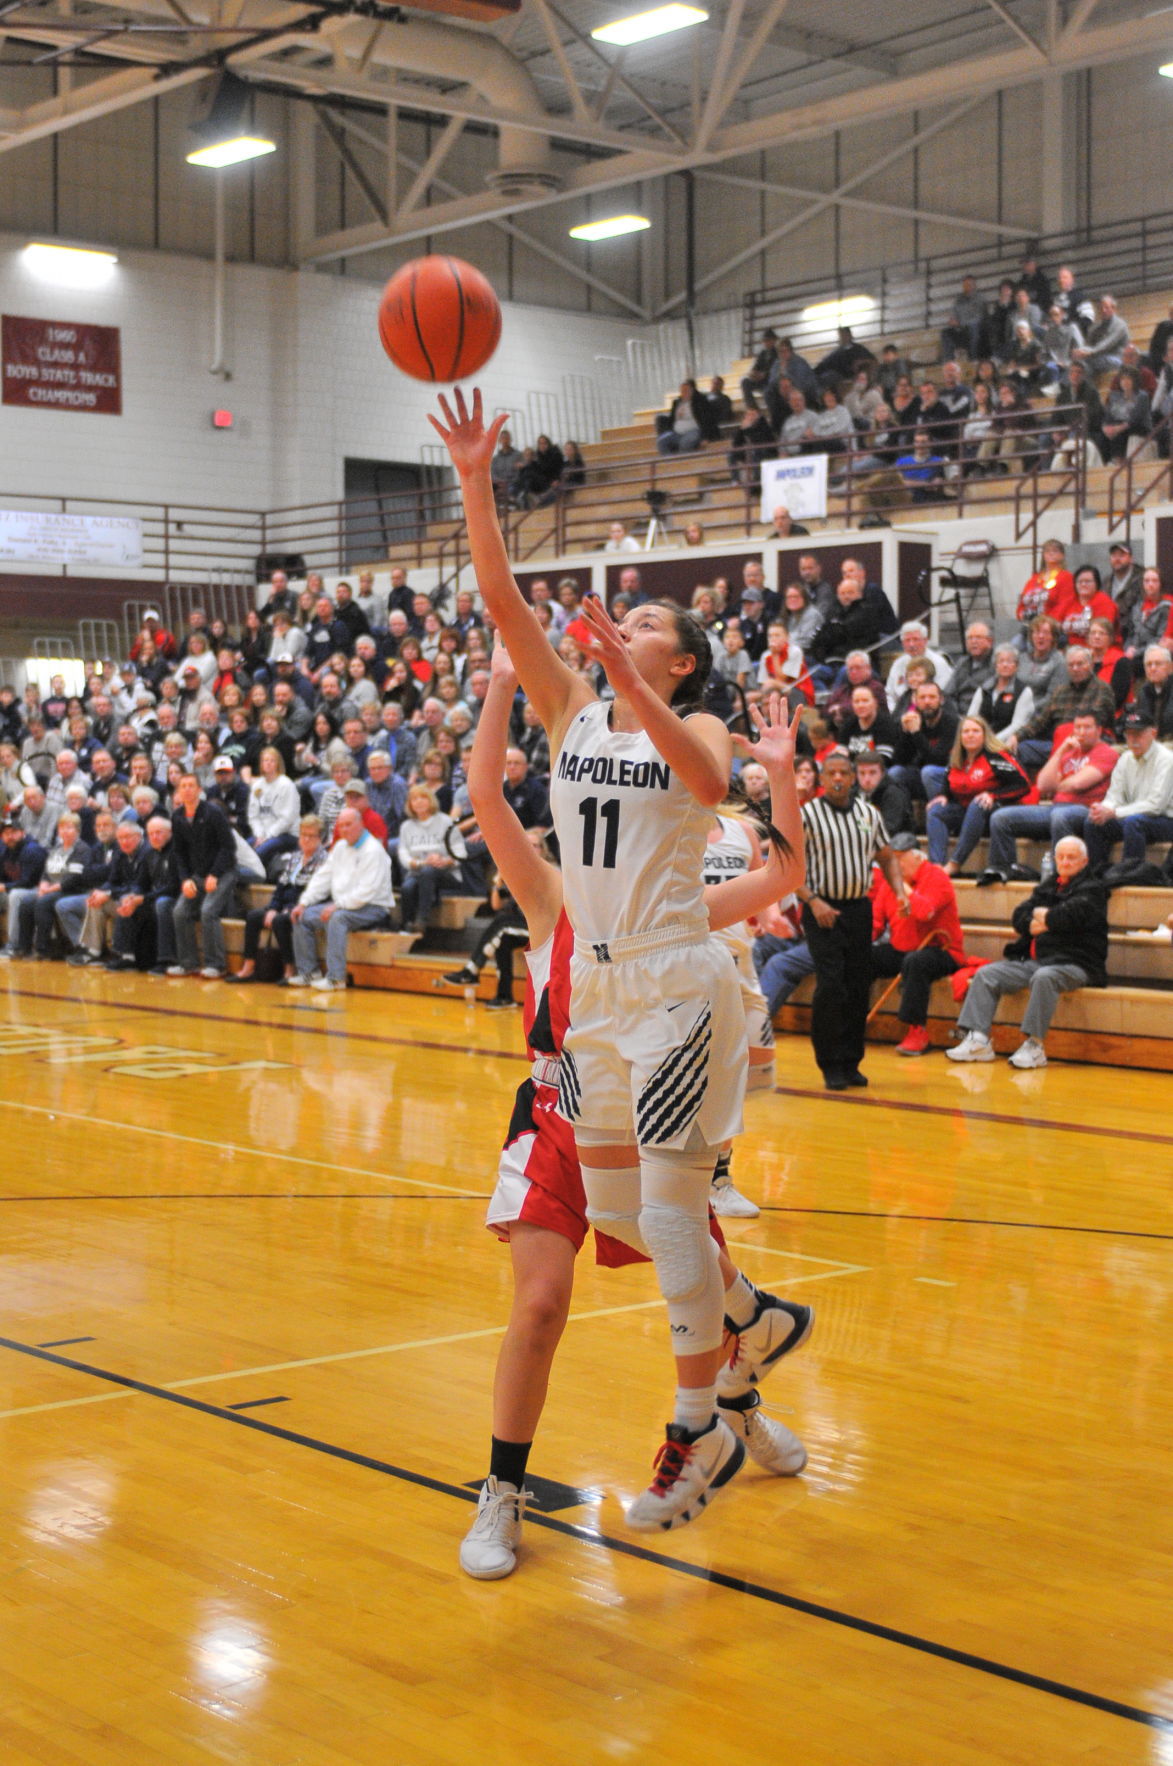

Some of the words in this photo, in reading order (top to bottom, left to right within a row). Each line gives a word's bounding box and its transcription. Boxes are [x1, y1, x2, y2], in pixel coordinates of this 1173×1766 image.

[37, 346, 75, 364] CLASS
[77, 351, 86, 364] A
[6, 363, 38, 379] BOYS
[41, 368, 77, 384] STATE
[79, 371, 117, 388] TRACK
[29, 387, 97, 406] CHAMPIONS
[558, 751, 671, 790] NAPOLEON
[578, 796, 620, 869] 11
